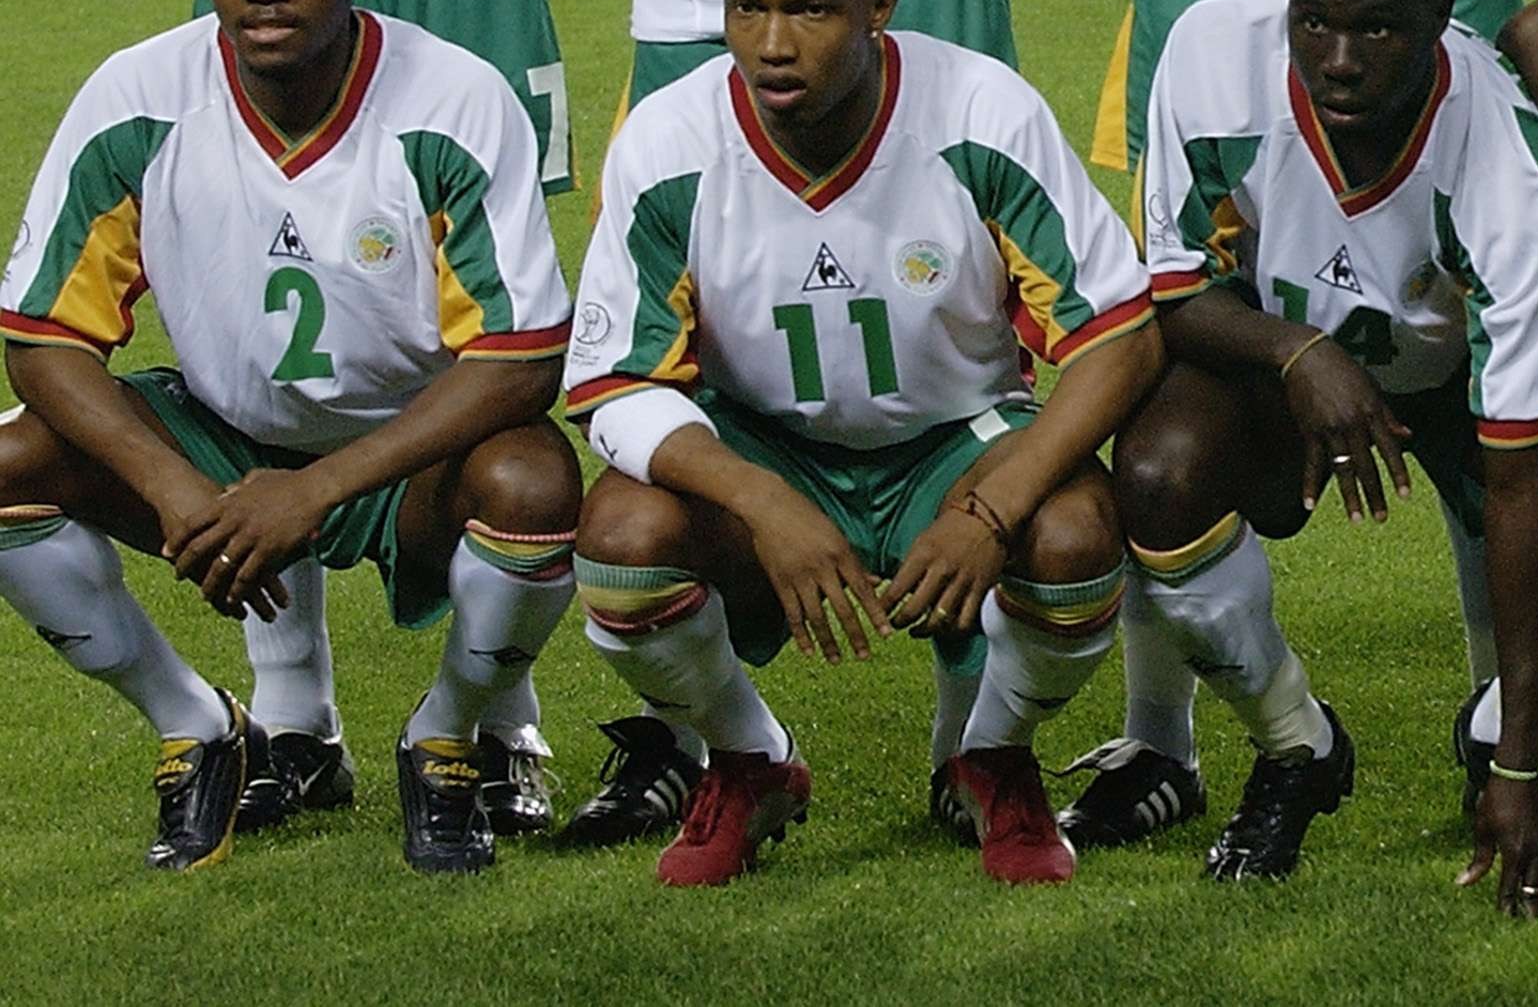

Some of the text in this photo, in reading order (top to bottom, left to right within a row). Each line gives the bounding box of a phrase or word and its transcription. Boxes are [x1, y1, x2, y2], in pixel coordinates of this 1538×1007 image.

[264, 267, 334, 381] 2
[773, 298, 899, 402] 11
[1273, 277, 1400, 366] 14
